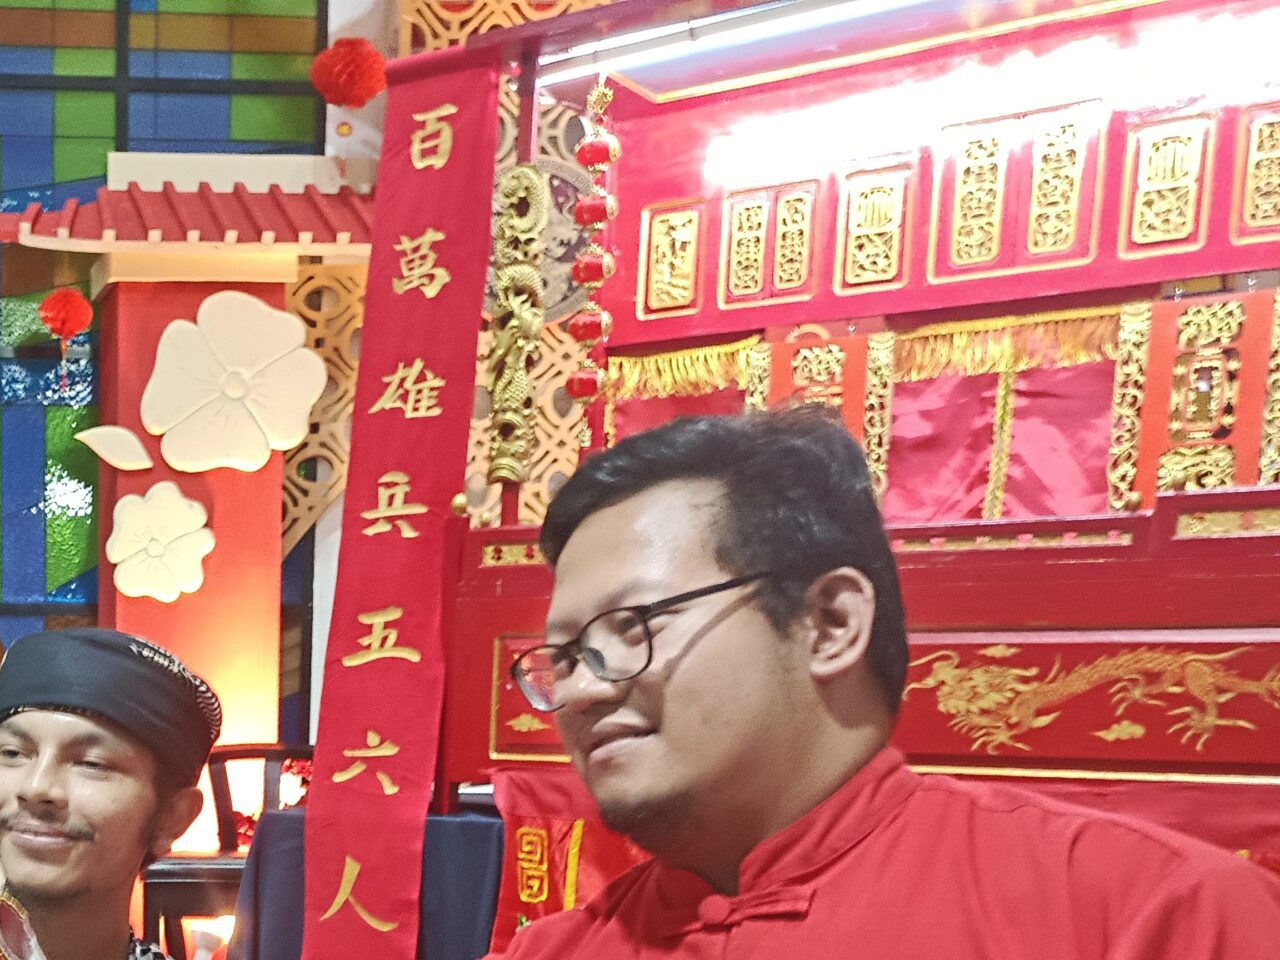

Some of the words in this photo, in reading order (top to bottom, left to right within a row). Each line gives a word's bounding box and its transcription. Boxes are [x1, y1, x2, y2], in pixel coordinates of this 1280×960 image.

[320, 103, 459, 932] 百萬雄兵五六人
